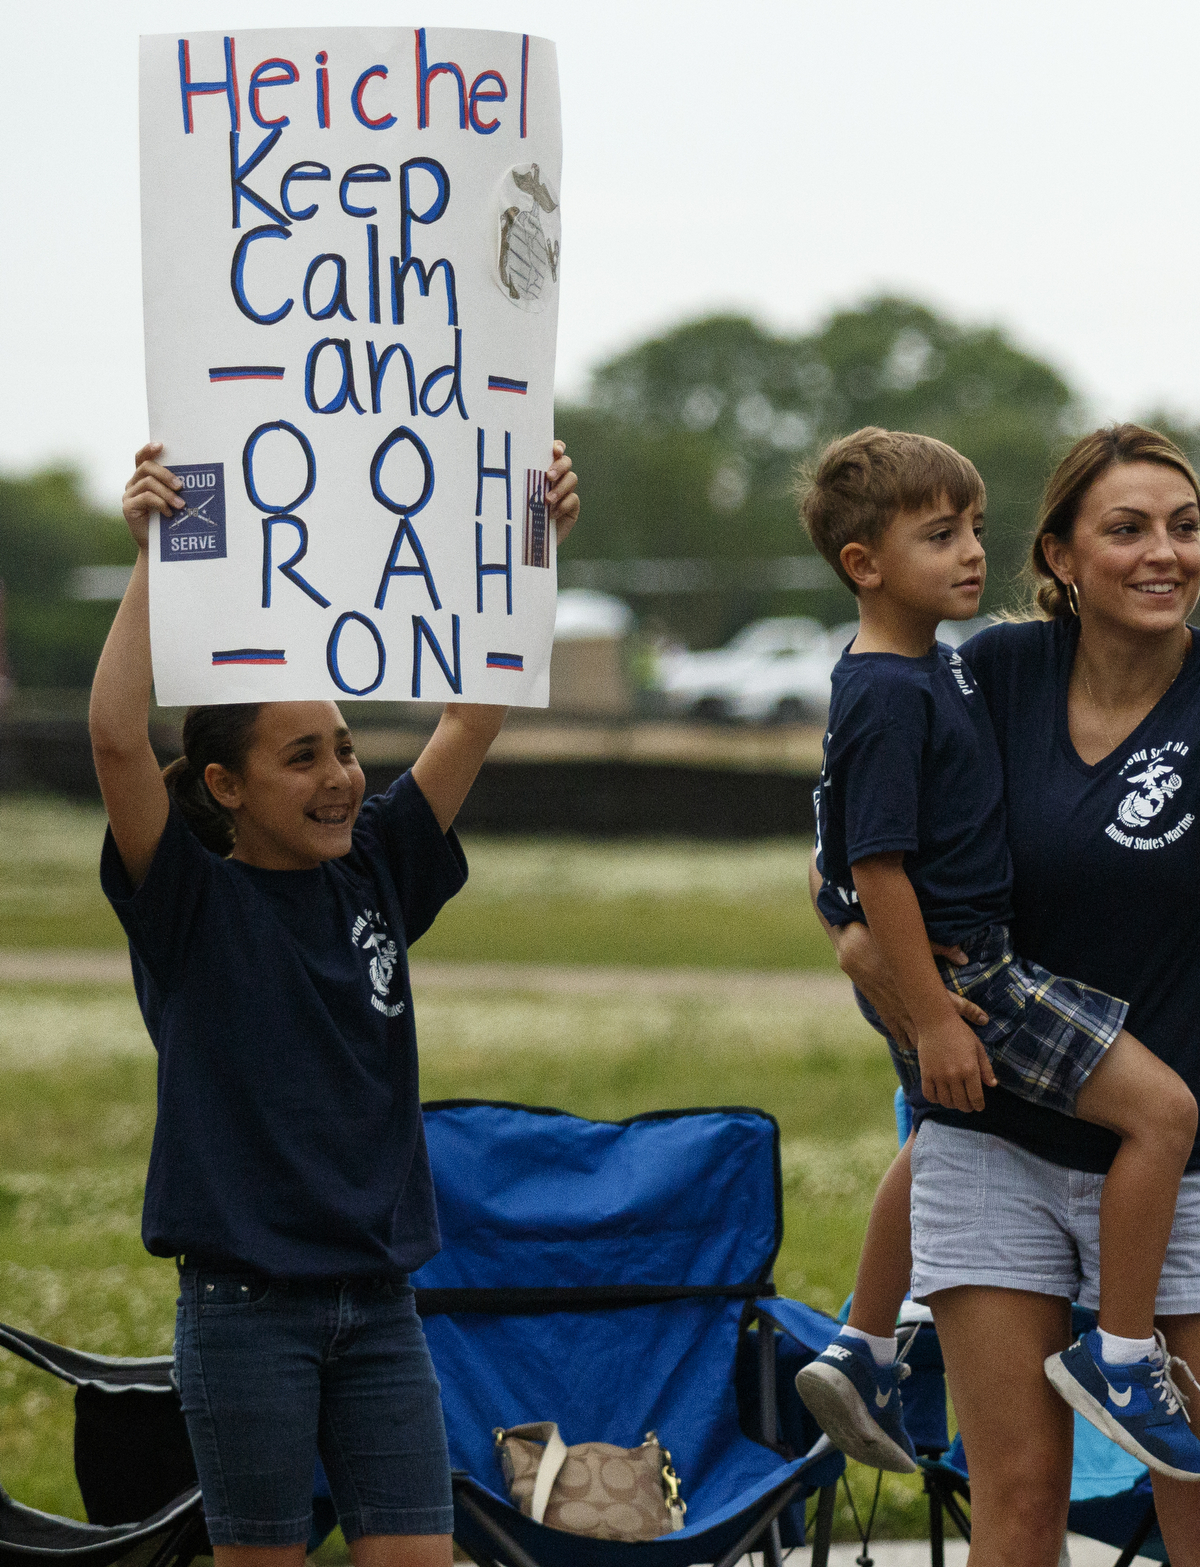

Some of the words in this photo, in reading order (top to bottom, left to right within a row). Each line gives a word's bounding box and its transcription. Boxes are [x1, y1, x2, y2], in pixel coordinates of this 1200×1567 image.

[178, 27, 530, 139] Heichel
[229, 127, 451, 262] Keep
[230, 224, 458, 326] Calm
[171, 535, 216, 552] SERVE
[326, 610, 463, 699] ON
[1104, 822, 1134, 849] United
[1133, 836, 1166, 850] States
[1163, 812, 1196, 845] Marine
